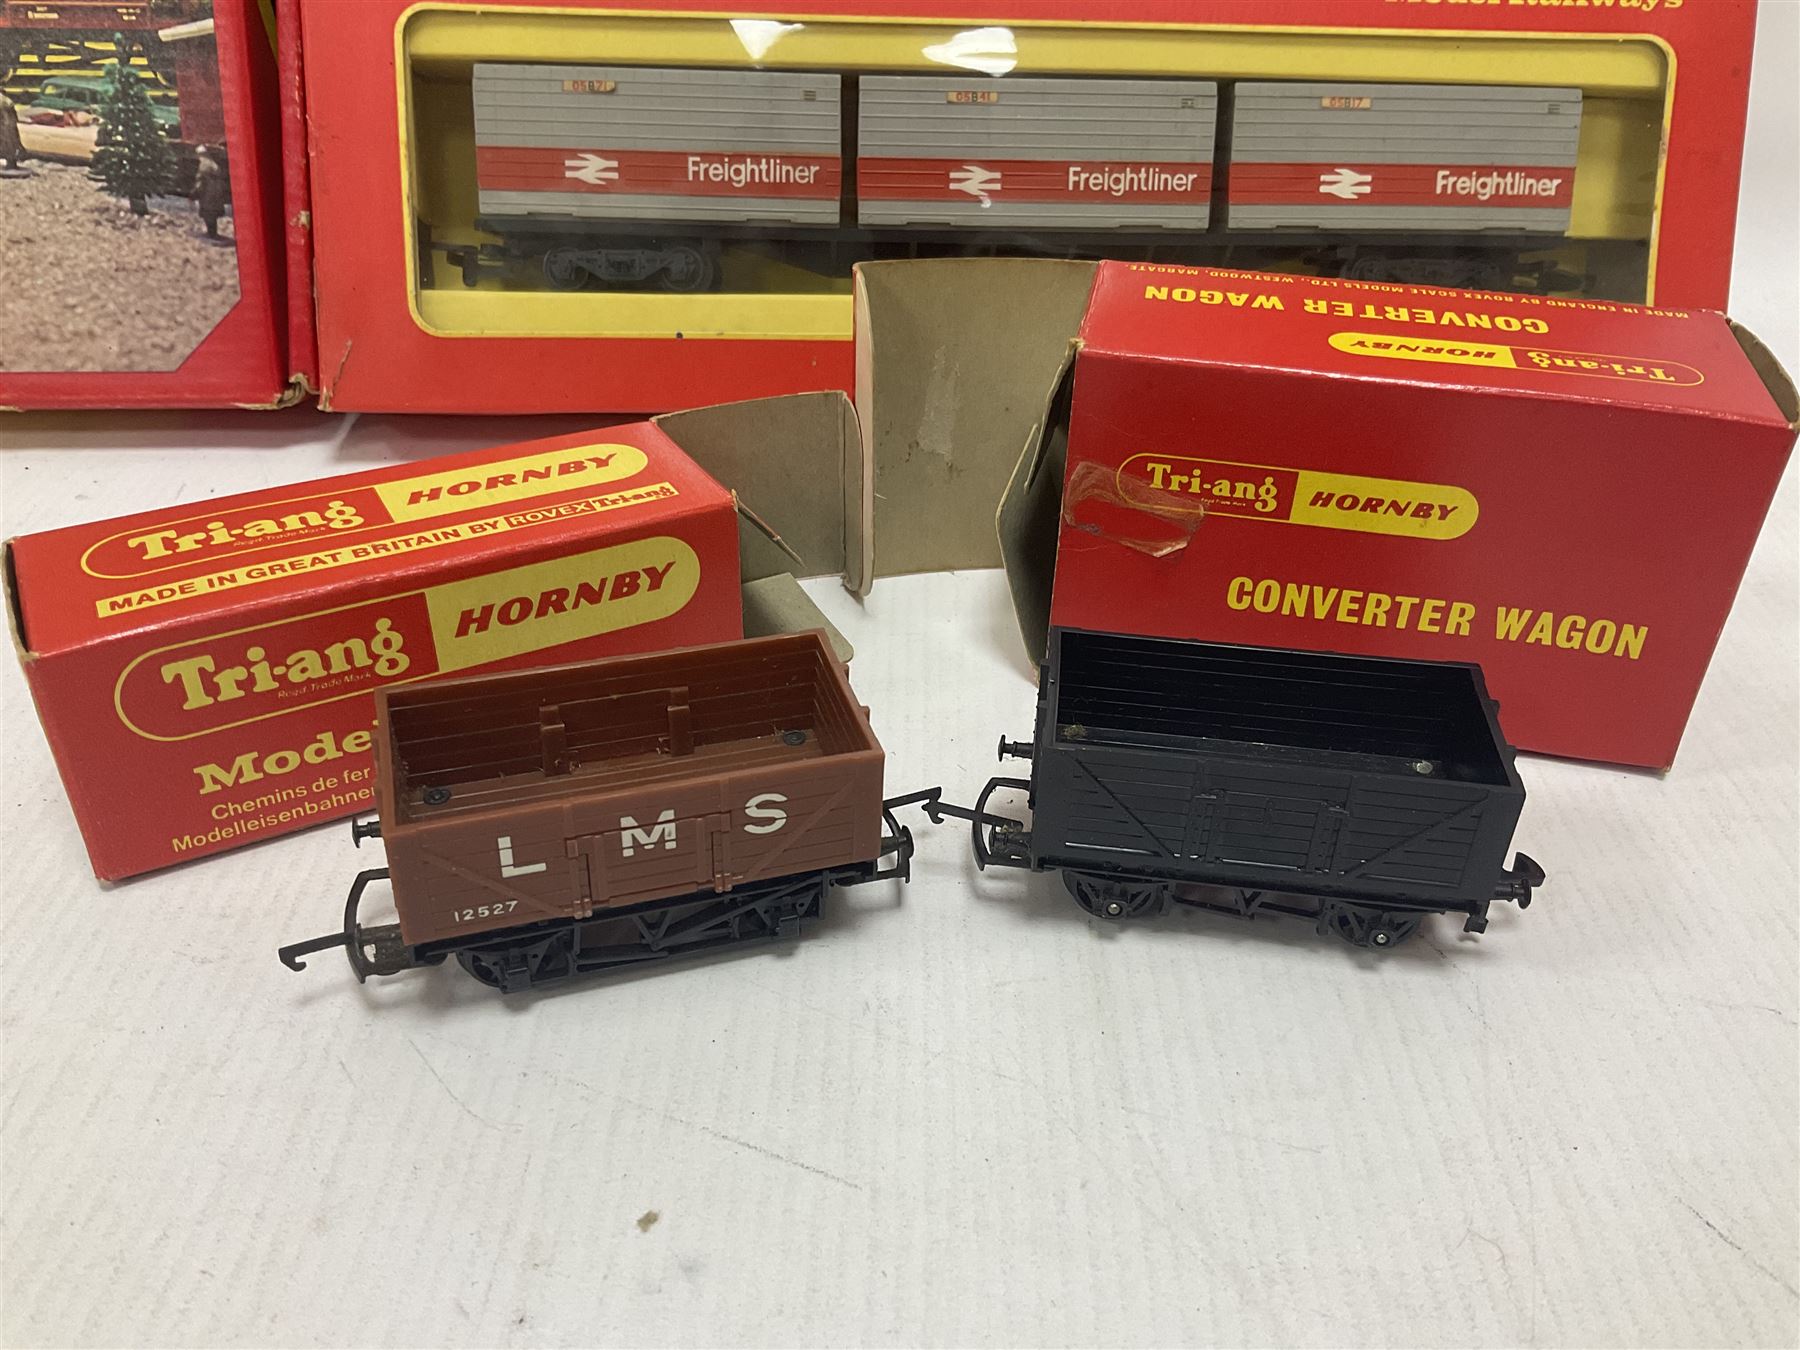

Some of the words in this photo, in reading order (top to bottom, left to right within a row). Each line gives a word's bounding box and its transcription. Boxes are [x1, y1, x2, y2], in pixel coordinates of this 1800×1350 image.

[687, 156, 820, 187] Freightliner
[1068, 166, 1198, 197] Freightliner
[1436, 170, 1562, 200] Freightliner
[1144, 285, 1284, 311] WAGON
[1344, 282, 1403, 293] MODELS
[1410, 287, 1457, 298] SCALE
[1464, 293, 1513, 302] ROVEX
[1521, 297, 1540, 305] BY
[1303, 298, 1549, 334] CONVERTER
[1546, 300, 1616, 312] ENGLAND
[1645, 309, 1689, 318] MADE
[1350, 339, 1497, 359] HORNBY
[1527, 350, 1676, 381] Tri-ang
[128, 500, 365, 561] Tri-ang
[405, 452, 618, 505] HORNBY
[1147, 462, 1278, 513] Tri-ang
[1308, 490, 1459, 521] HORNBY
[108, 581, 197, 612] MADE
[207, 573, 237, 589] IN
[245, 552, 343, 580] GREAT
[351, 529, 461, 561] BRITAIN
[468, 520, 504, 535] BY
[510, 501, 592, 526] ROVEX
[592, 485, 674, 508] Tri-ang
[1227, 576, 1475, 637] CONVERTER
[1496, 605, 1649, 661] WAGON
[160, 617, 411, 711] Tri-ang
[454, 562, 678, 639] HORNBY
[193, 720, 379, 795] Mode
[211, 784, 308, 820] Chemins
[312, 775, 338, 793] de
[343, 766, 371, 785] fer
[497, 836, 547, 878] L
[619, 809, 678, 858] M
[743, 793, 788, 835] S
[454, 900, 519, 923] 12527
